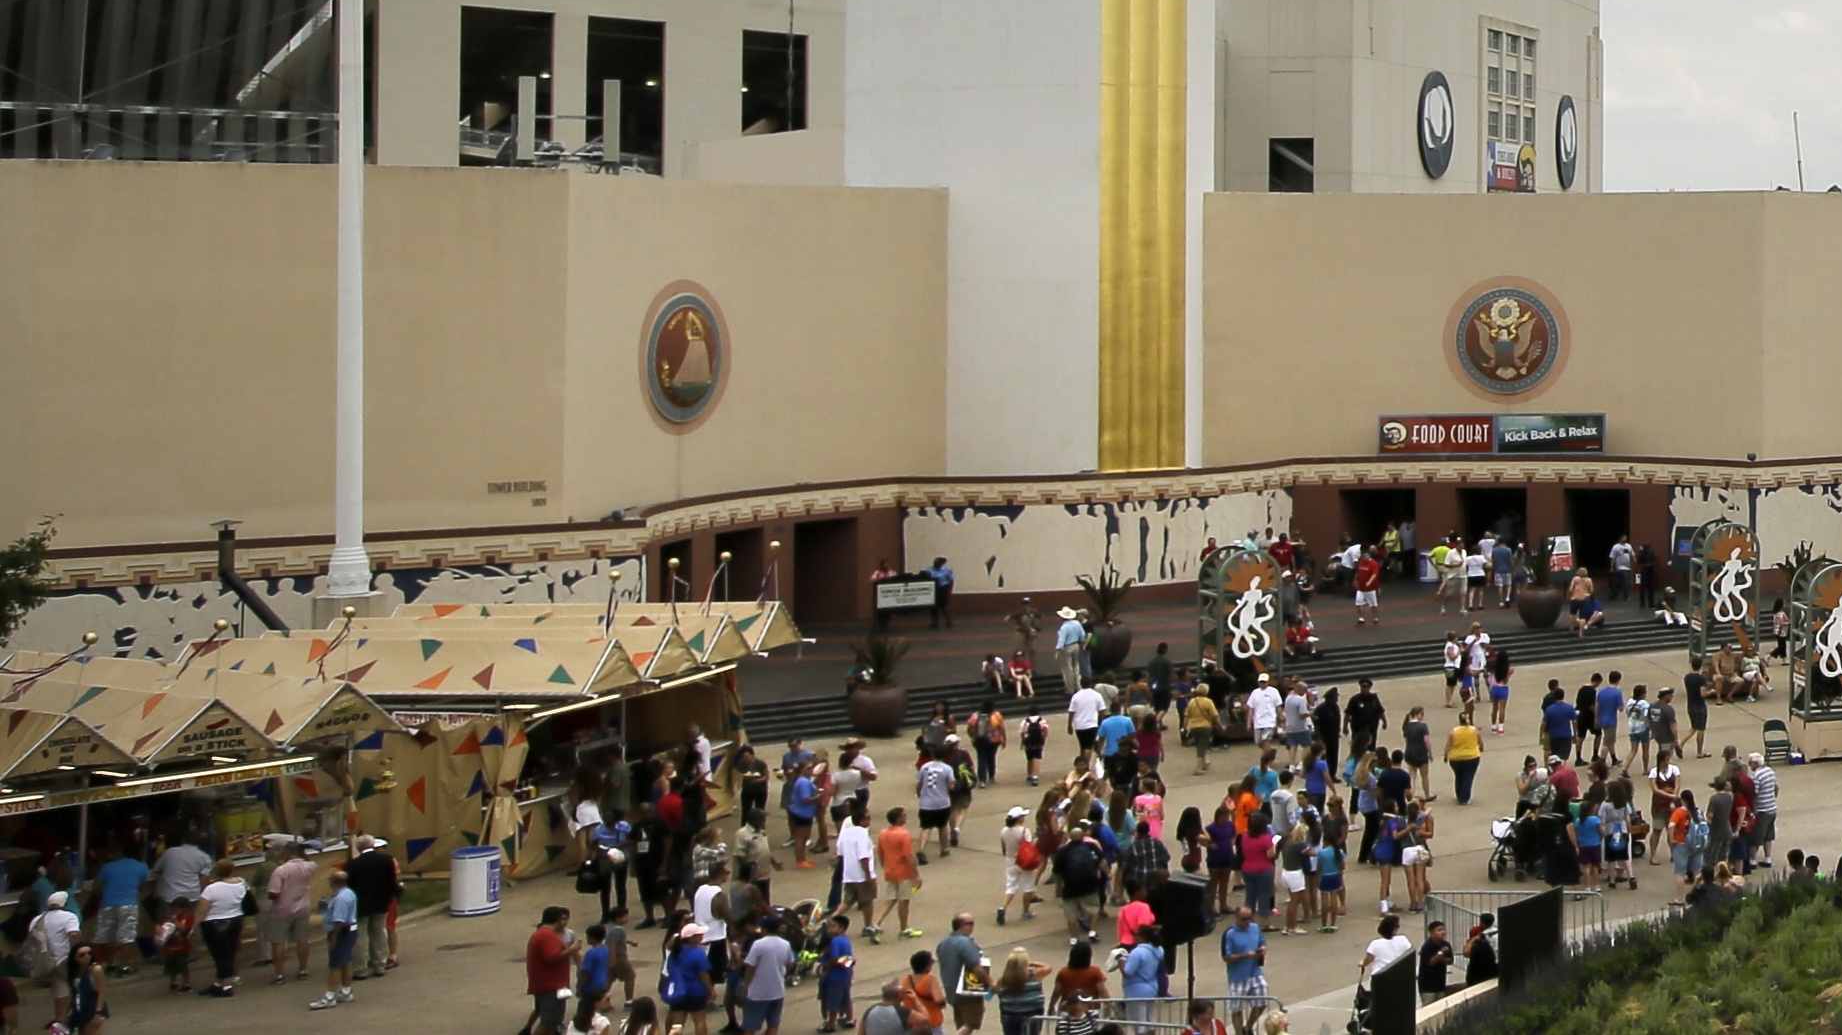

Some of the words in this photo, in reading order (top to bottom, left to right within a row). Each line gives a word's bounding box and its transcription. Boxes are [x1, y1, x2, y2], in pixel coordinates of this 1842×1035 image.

[1411, 424, 1446, 444] FOOD
[1450, 424, 1489, 444] COURT
[1504, 431, 1528, 442] Kick
[1530, 429, 1557, 440] Back
[1558, 428, 1567, 438] &
[1568, 426, 1597, 437] Relax
[183, 726, 243, 743] SAUSAGE
[177, 745, 192, 754] on
[207, 738, 246, 750] STICK
